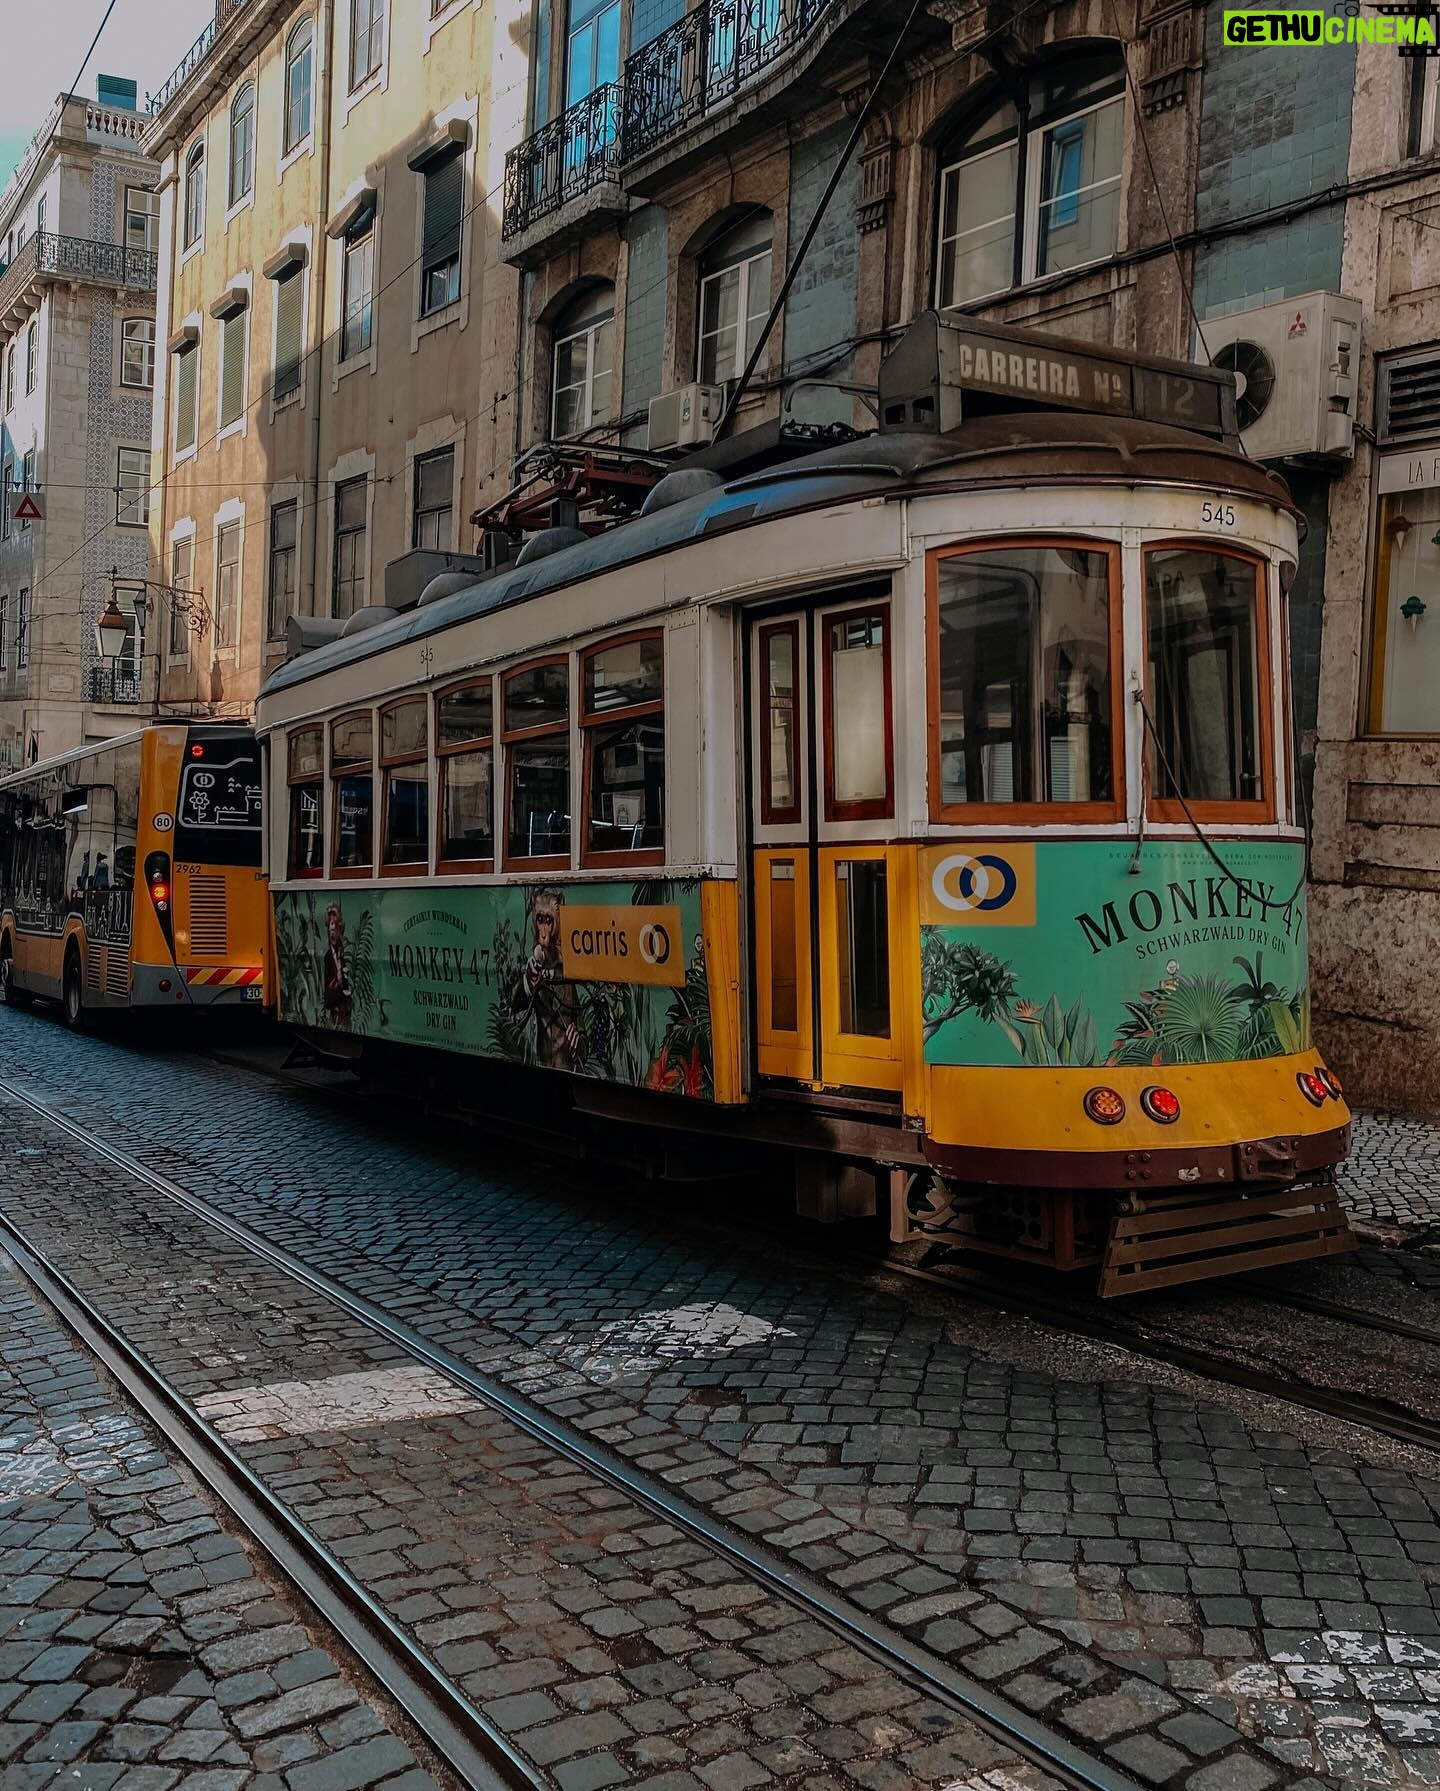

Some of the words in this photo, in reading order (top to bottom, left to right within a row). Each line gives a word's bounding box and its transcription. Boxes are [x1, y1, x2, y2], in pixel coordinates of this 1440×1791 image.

[959, 343, 1081, 399] CARREIRA
[1157, 374, 1195, 416] 12
[1408, 460, 1424, 484] LA
[1201, 502, 1235, 526] 545
[420, 647, 434, 664] 545
[156, 817, 170, 827] 80
[176, 864, 201, 874] 2962
[1074, 877, 1275, 954] MONKEY
[1282, 902, 1303, 946] 47
[570, 919, 628, 958] carris
[1135, 925, 1245, 960] SCHWARZWALD
[1249, 928, 1269, 945] DRY
[1271, 936, 1287, 955] GIN
[388, 944, 464, 983] MONKEY
[470, 948, 490, 987] 47
[413, 989, 469, 1011] SCHWARZWALD
[426, 1011, 441, 1028] DRY
[443, 1014, 457, 1031] GIN
